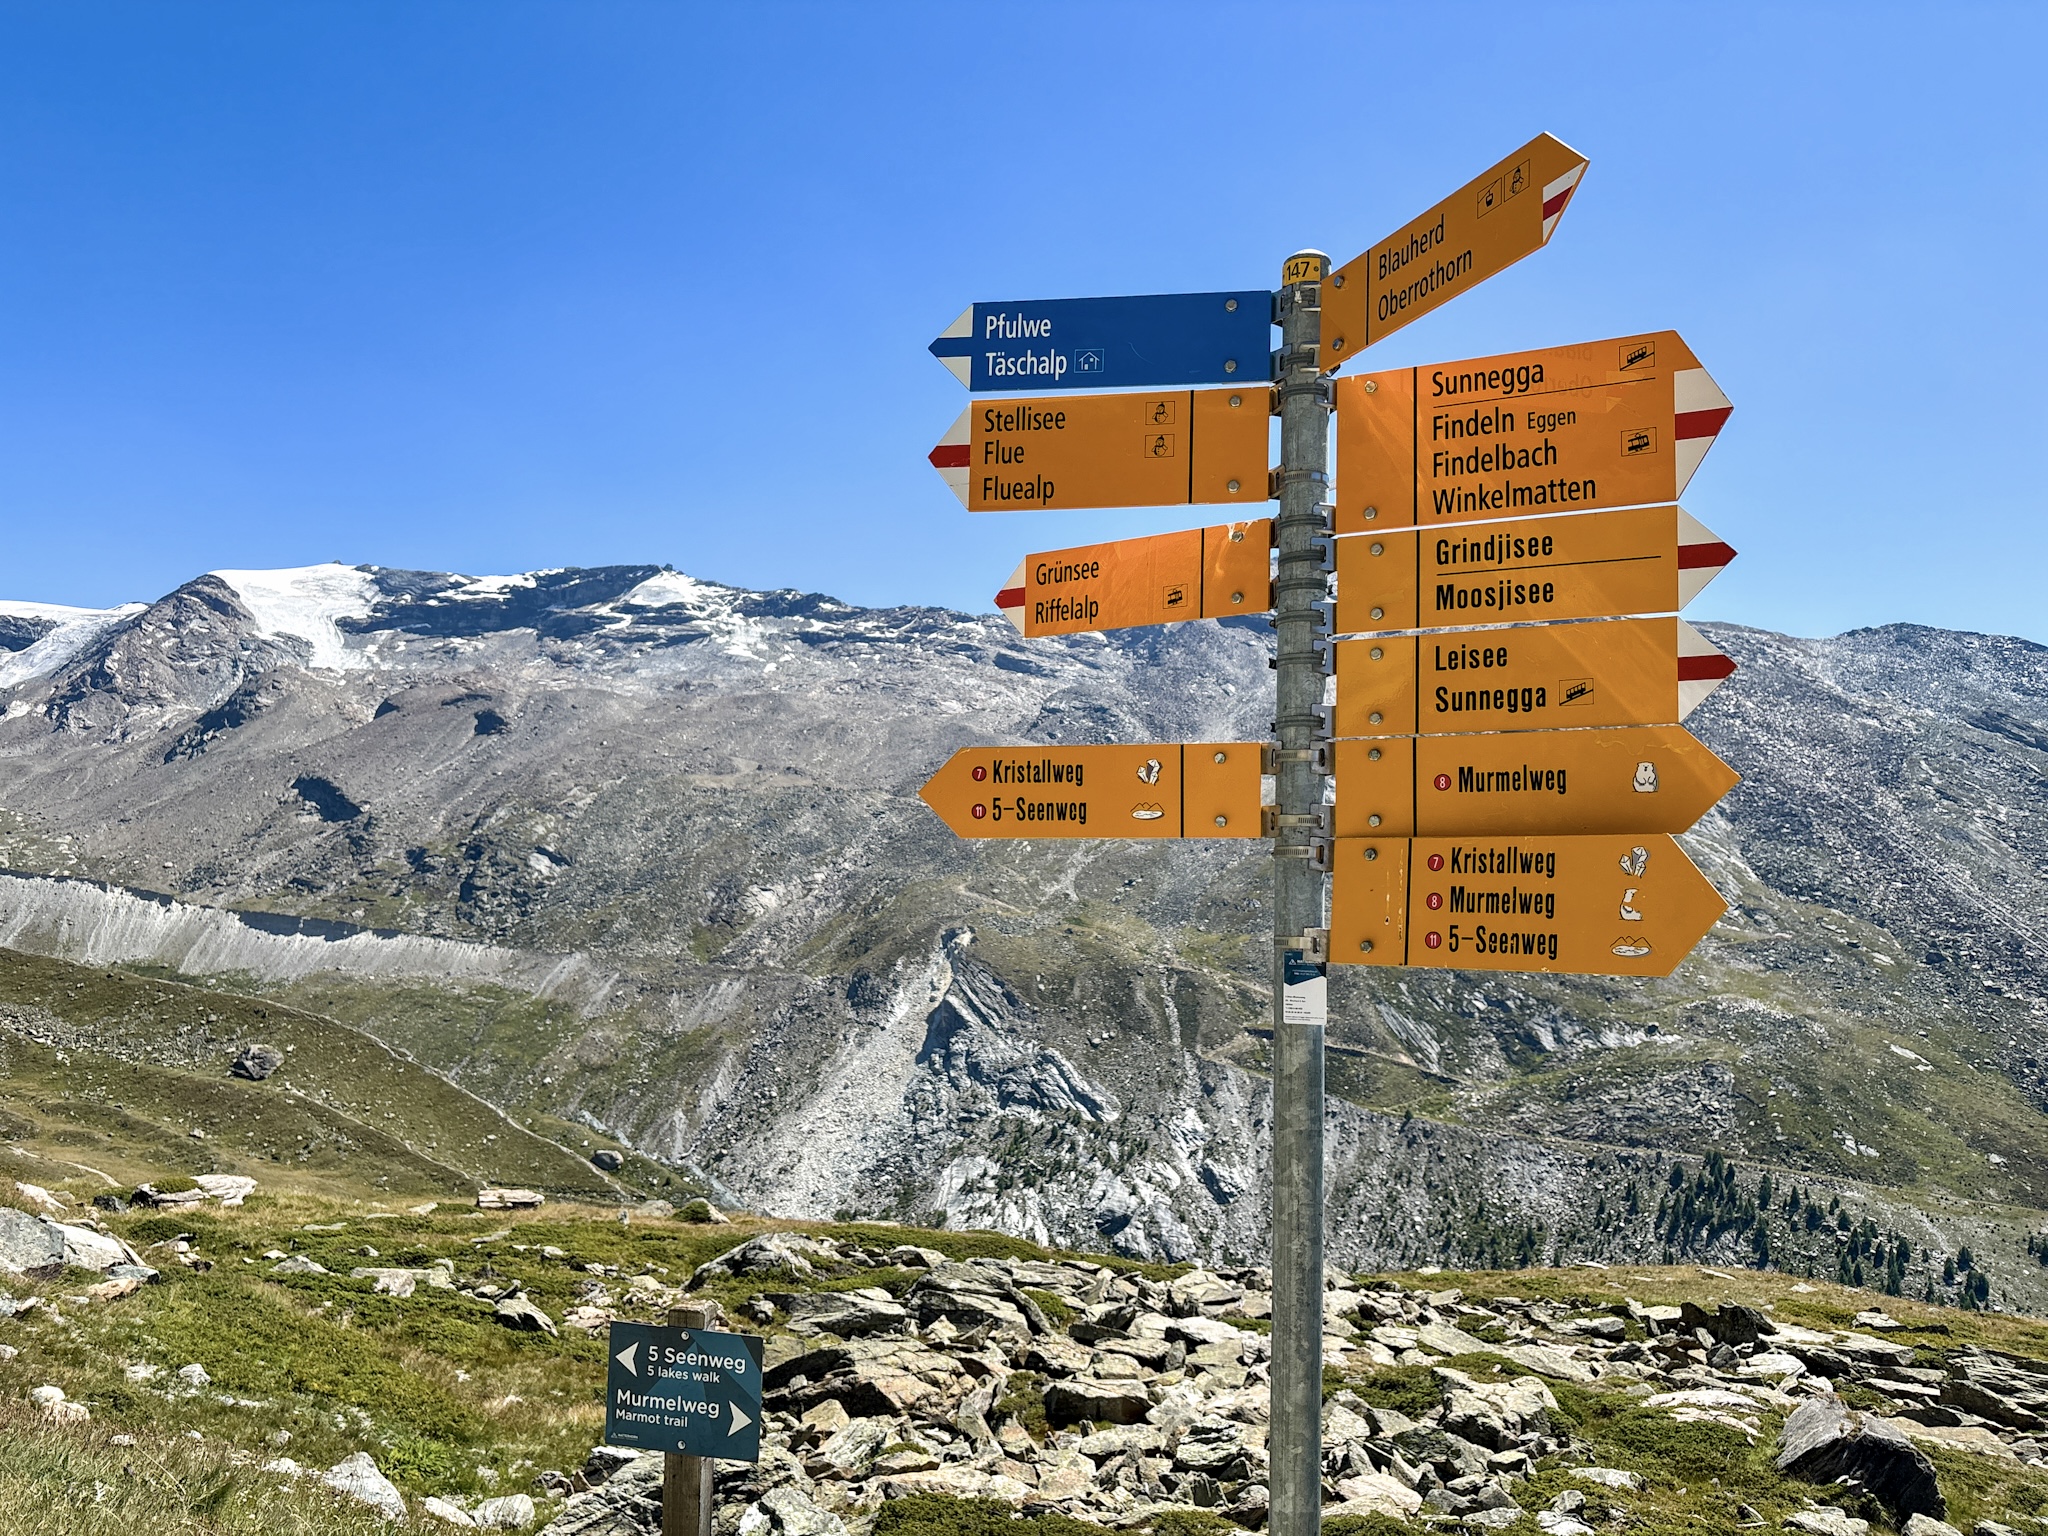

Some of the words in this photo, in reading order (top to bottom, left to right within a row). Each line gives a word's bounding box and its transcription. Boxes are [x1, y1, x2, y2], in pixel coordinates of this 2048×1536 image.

[1378, 213, 1445, 281] Blauherd
[1286, 261, 1311, 281] 147
[1378, 249, 1472, 322] Oberrothorn
[986, 312, 1051, 339] Pfulwe
[985, 348, 1067, 381] Täschalp
[1432, 363, 1544, 395] Sunnegga
[984, 406, 1066, 433] Stellisee
[1433, 406, 1515, 441] Findeln
[1527, 411, 1576, 434] Eggen
[984, 439, 1025, 465] Flue
[1433, 438, 1557, 478] Findelbach
[983, 474, 1055, 506] Fluealp
[1432, 477, 1596, 515] Winkelmatten
[1436, 534, 1554, 565] Grindjisee
[1036, 561, 1099, 586] Grünsee
[1035, 594, 1099, 625] Riffelalp
[1436, 579, 1554, 611] Moosjisee
[1435, 643, 1508, 671] Leisee
[1435, 686, 1546, 714] Sunnegga
[993, 759, 1083, 787] Kristallweg
[1458, 764, 1567, 795] Murmelweg
[1451, 846, 1556, 879] Kristallweg
[1449, 885, 1555, 920] Murmelweg
[647, 1365, 655, 1376] 5
[658, 1365, 689, 1380] lakes
[692, 1371, 720, 1384] walk
[648, 1345, 659, 1362] 5
[664, 1347, 746, 1374] Seenweg
[615, 1408, 661, 1425] Marmot
[664, 1415, 688, 1428] trail
[616, 1388, 720, 1419] Murmelweg
